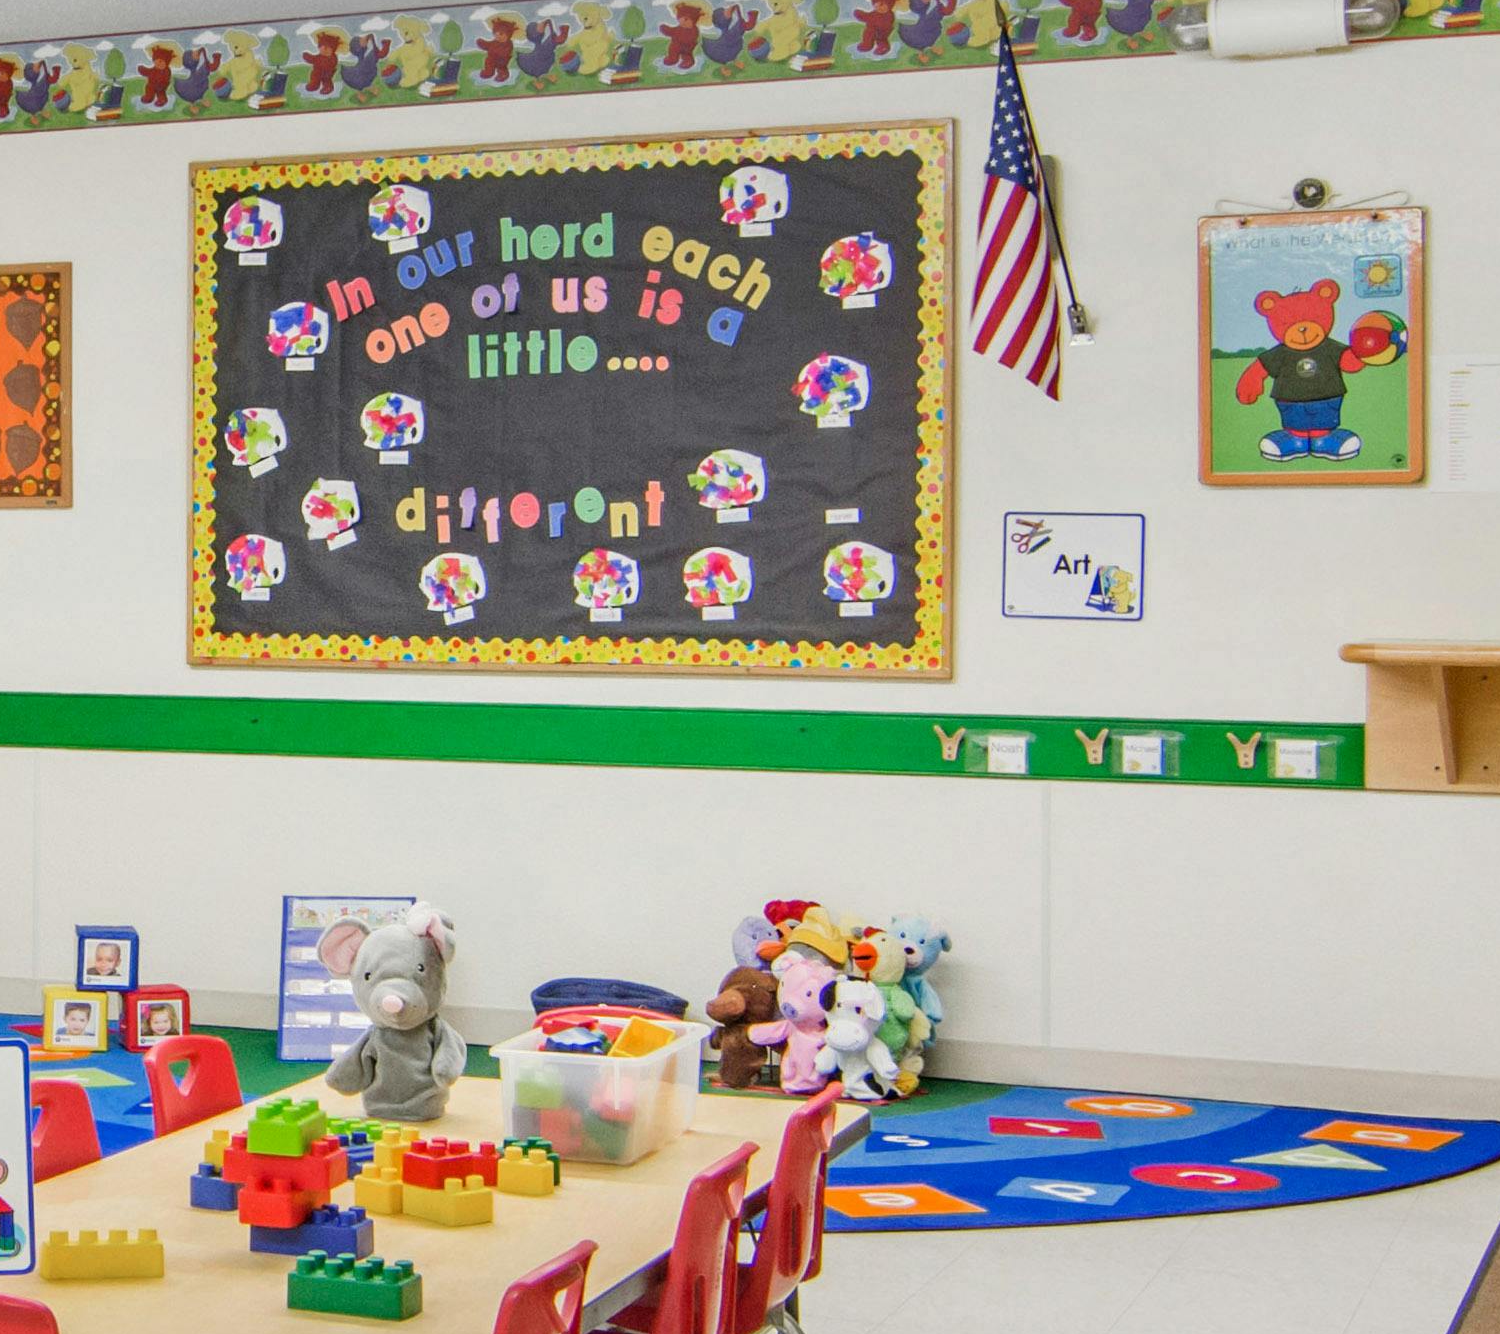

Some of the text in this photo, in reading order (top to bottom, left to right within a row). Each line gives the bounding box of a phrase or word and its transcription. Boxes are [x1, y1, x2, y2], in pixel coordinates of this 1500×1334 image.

[326, 212, 772, 322] In our herd each
[365, 269, 744, 364] one of us is a
[396, 479, 665, 544] different
[1053, 554, 1091, 574] Art
[991, 740, 1023, 754] Noah
